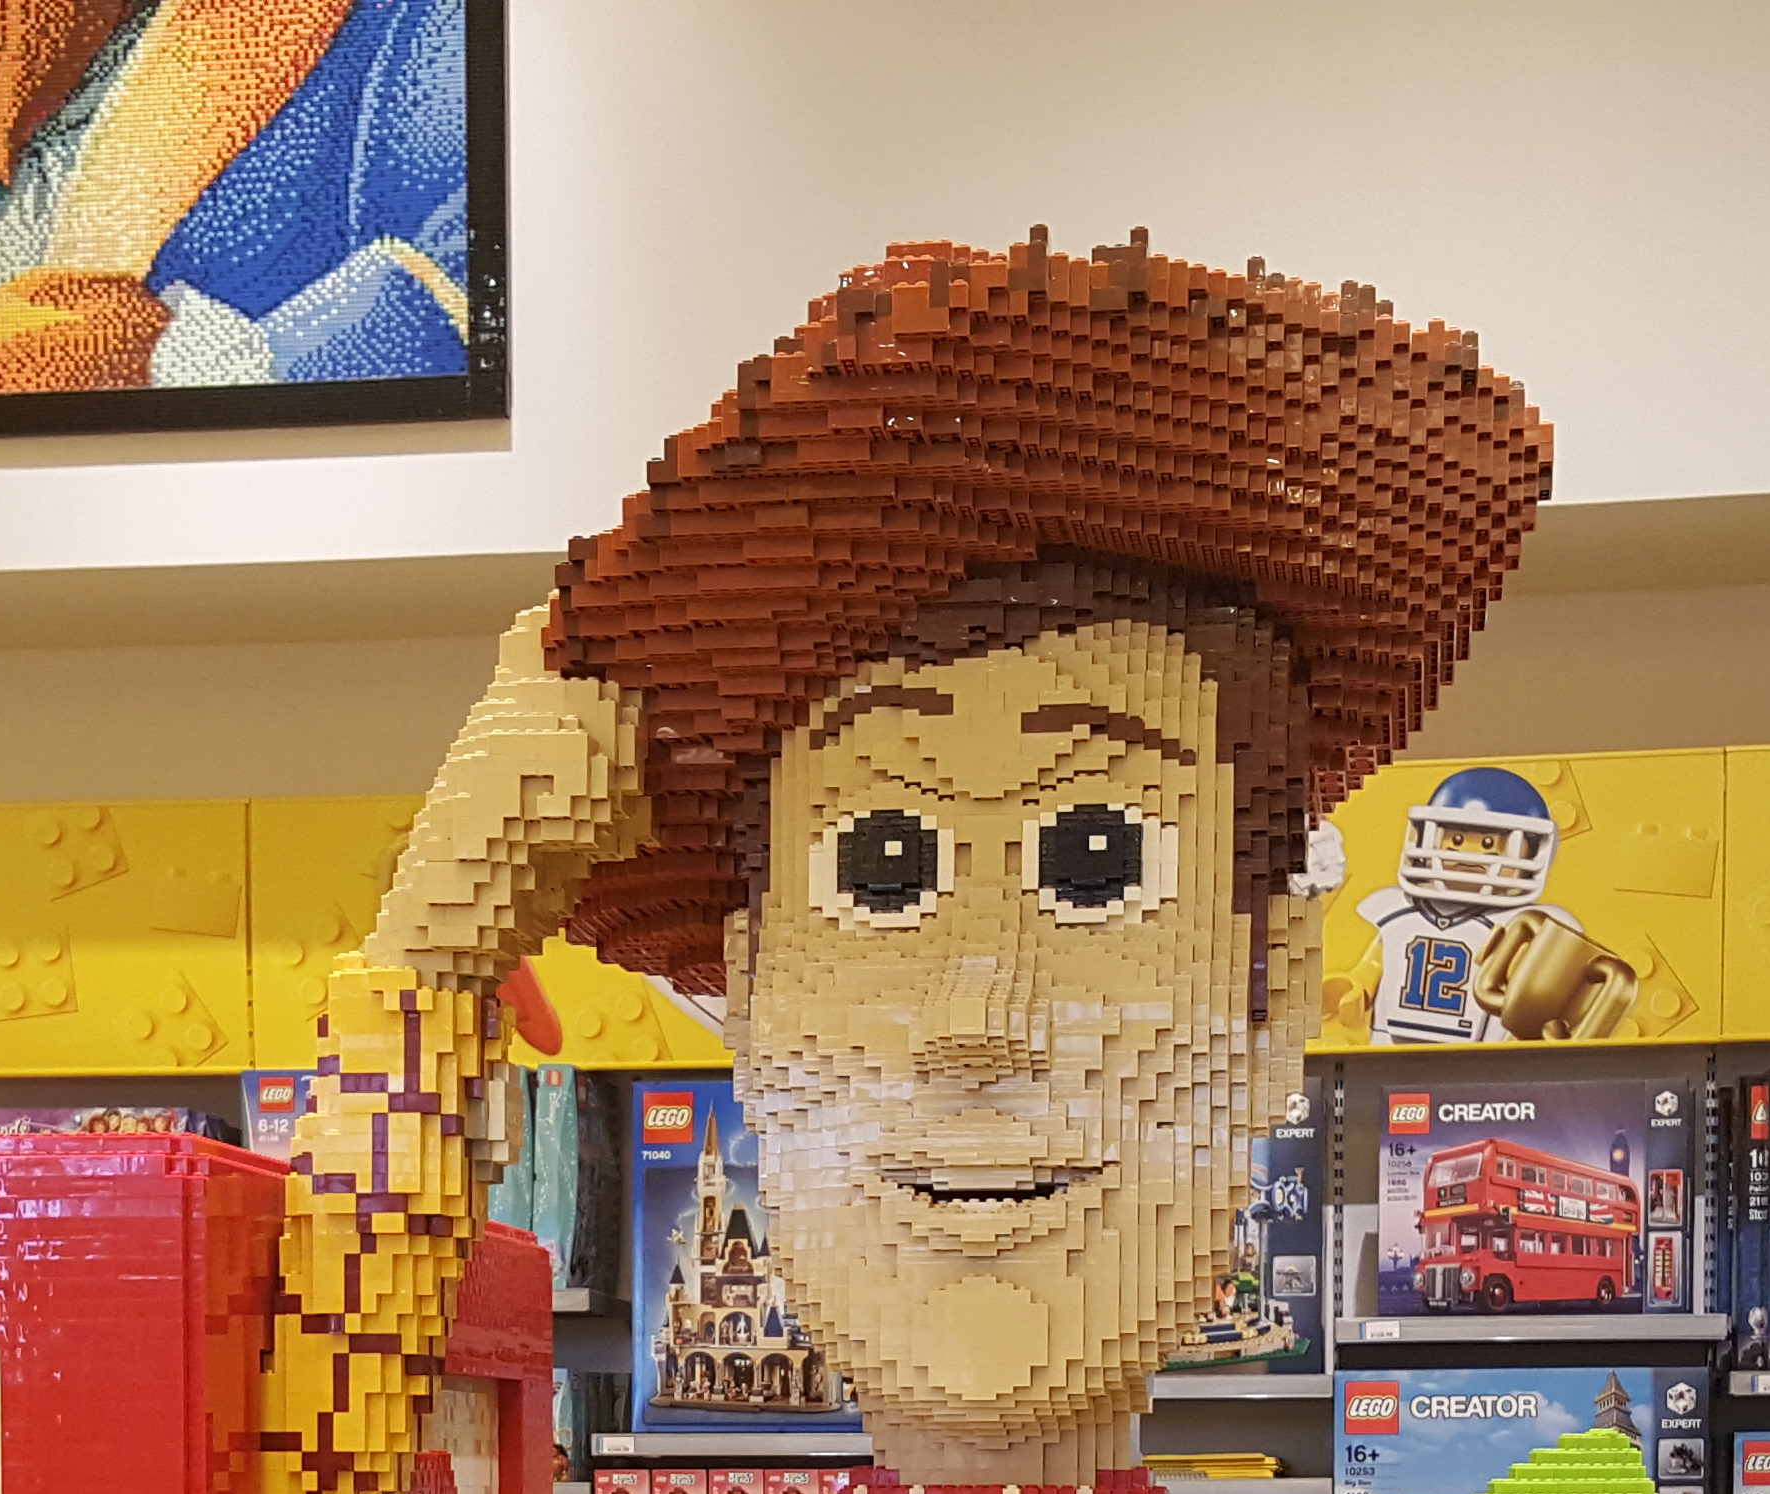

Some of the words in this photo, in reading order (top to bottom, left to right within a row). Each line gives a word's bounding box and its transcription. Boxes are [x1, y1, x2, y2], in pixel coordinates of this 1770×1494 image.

[1398, 935, 1472, 1017] 12
[260, 1086, 294, 1103] LEGO
[644, 1106, 692, 1130] LEGO
[1389, 1104, 1429, 1123] LEGO
[1438, 1102, 1536, 1122] CREATOR
[1650, 1117, 1683, 1127] EXPERT
[1275, 1127, 1316, 1139] EXPERT
[641, 1151, 672, 1161] 71040
[1388, 1142, 1417, 1158] 16+
[1347, 1396, 1399, 1420] LEGO
[1409, 1394, 1539, 1420] CREATOR
[1661, 1417, 1703, 1430] EXPERT
[1345, 1444, 1381, 1464] 16+
[1344, 1466, 1376, 1477] 10253
